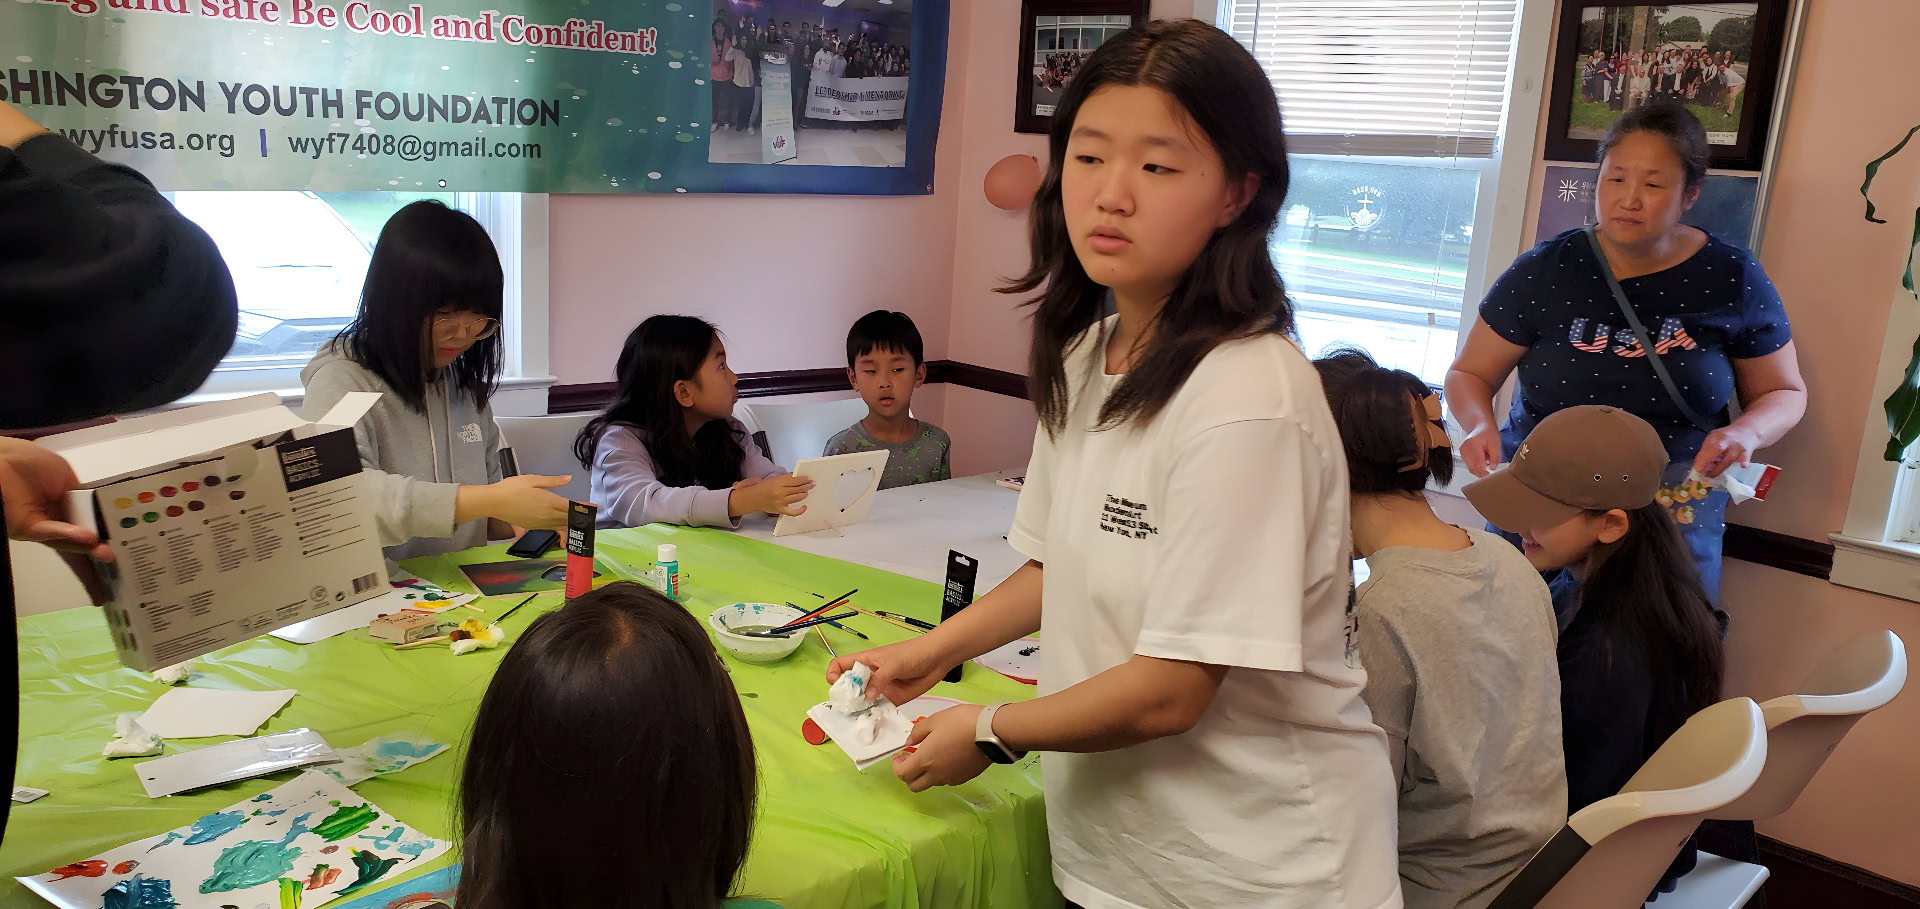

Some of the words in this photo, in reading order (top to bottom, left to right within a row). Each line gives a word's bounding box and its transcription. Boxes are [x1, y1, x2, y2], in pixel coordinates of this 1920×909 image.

[201, 0, 280, 23] safe
[290, 0, 336, 28] Be
[345, 2, 423, 36] Cool
[433, 13, 496, 41] and
[502, 17, 657, 54] Confident!
[0, 68, 205, 112] HINGTON
[218, 81, 344, 118] YOUTH
[356, 89, 560, 127] FOUNDATION
[288, 131, 542, 162] wyf7408@gmail.com
[1568, 316, 1698, 358] USA
